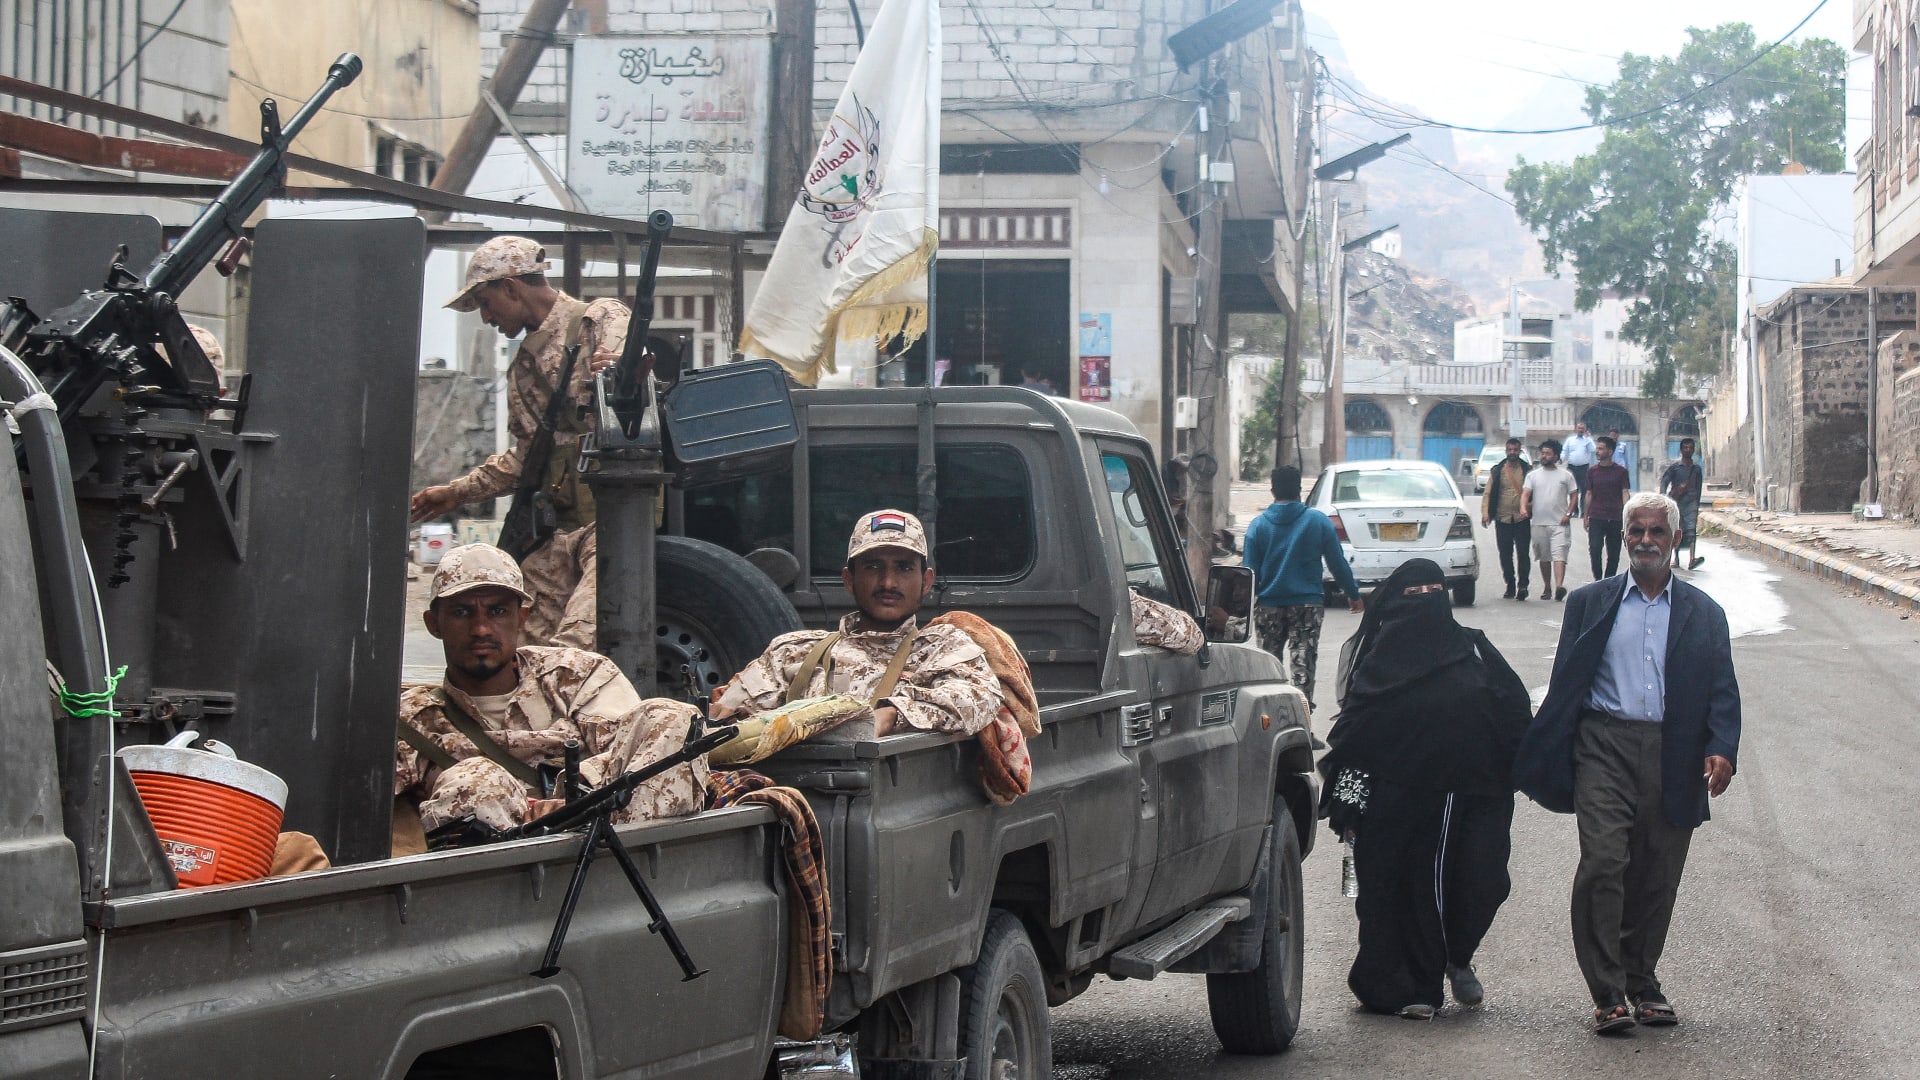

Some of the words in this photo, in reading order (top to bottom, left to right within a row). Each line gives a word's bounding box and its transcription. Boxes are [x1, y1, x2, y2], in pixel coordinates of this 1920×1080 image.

[619, 46, 725, 85] مخبازة
[595, 93, 669, 135] صيرة
[679, 88, 747, 125] قلعة
